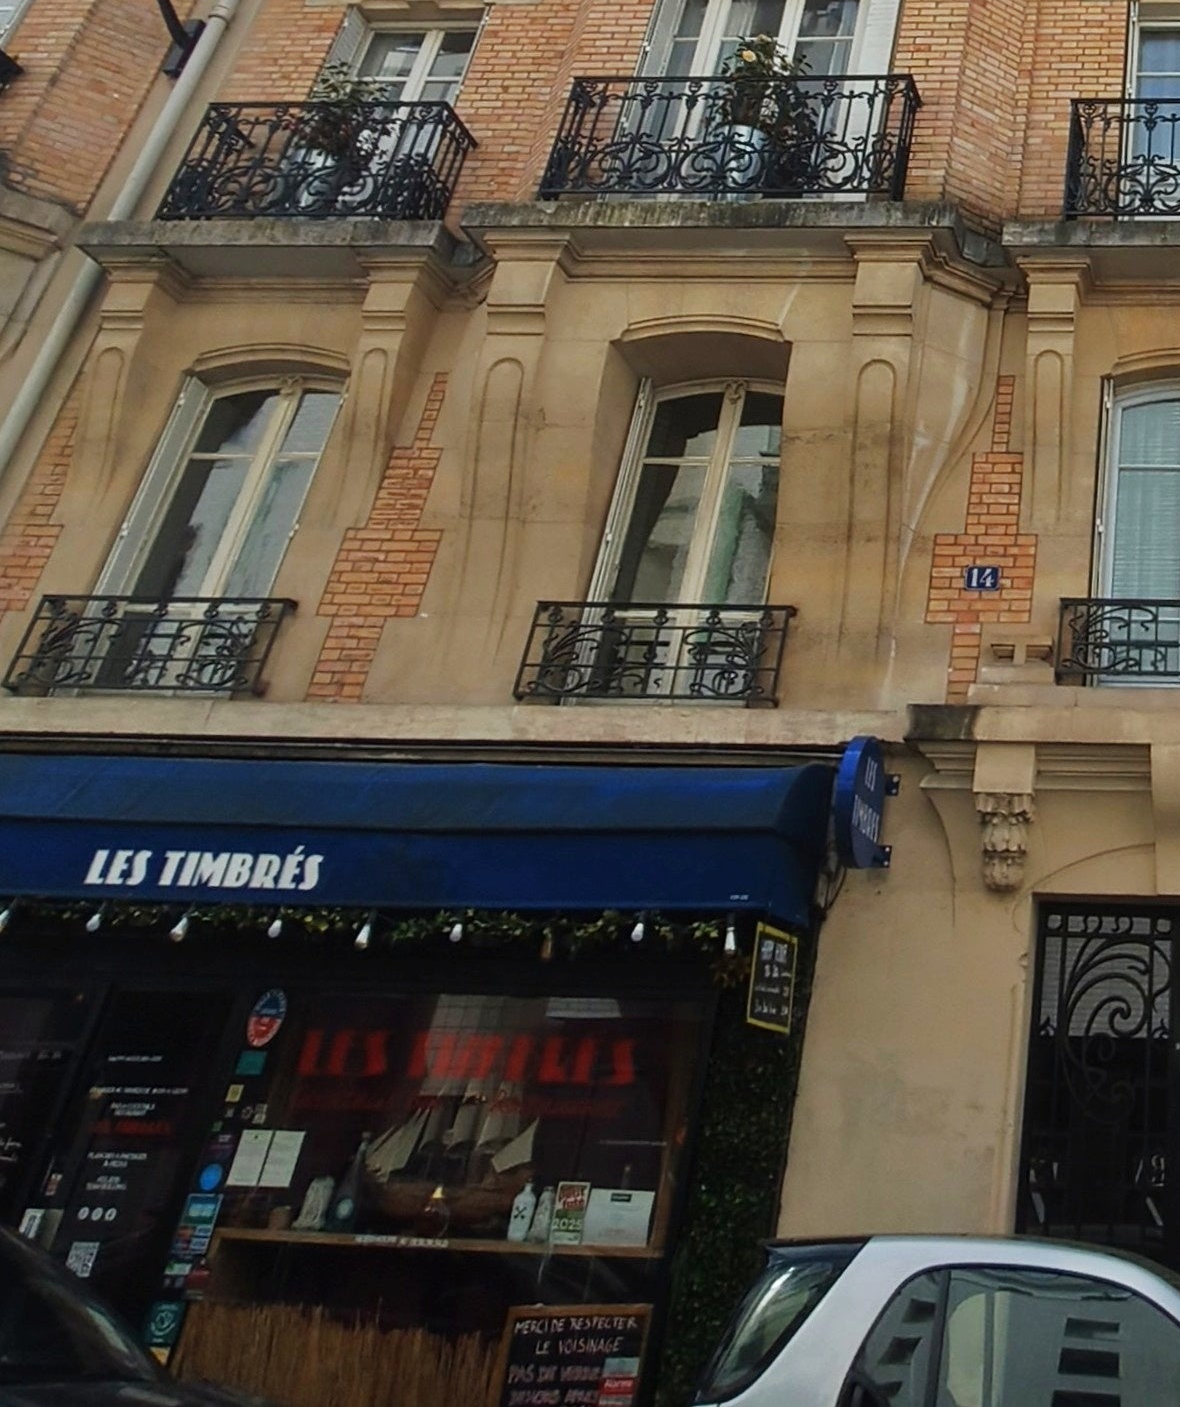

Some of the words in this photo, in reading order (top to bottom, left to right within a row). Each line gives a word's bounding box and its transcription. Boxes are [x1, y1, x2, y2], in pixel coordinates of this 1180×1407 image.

[971, 568, 995, 588] 14
[83, 848, 153, 886] LES
[157, 845, 325, 890] TIMBRÉS
[551, 1217, 583, 1230] 2025
[514, 1316, 549, 1335] MERCI
[550, 1317, 566, 1333] DE
[569, 1315, 639, 1331] RESPECTER
[535, 1339, 552, 1355] LE
[558, 1336, 625, 1354] VOISINAGE
